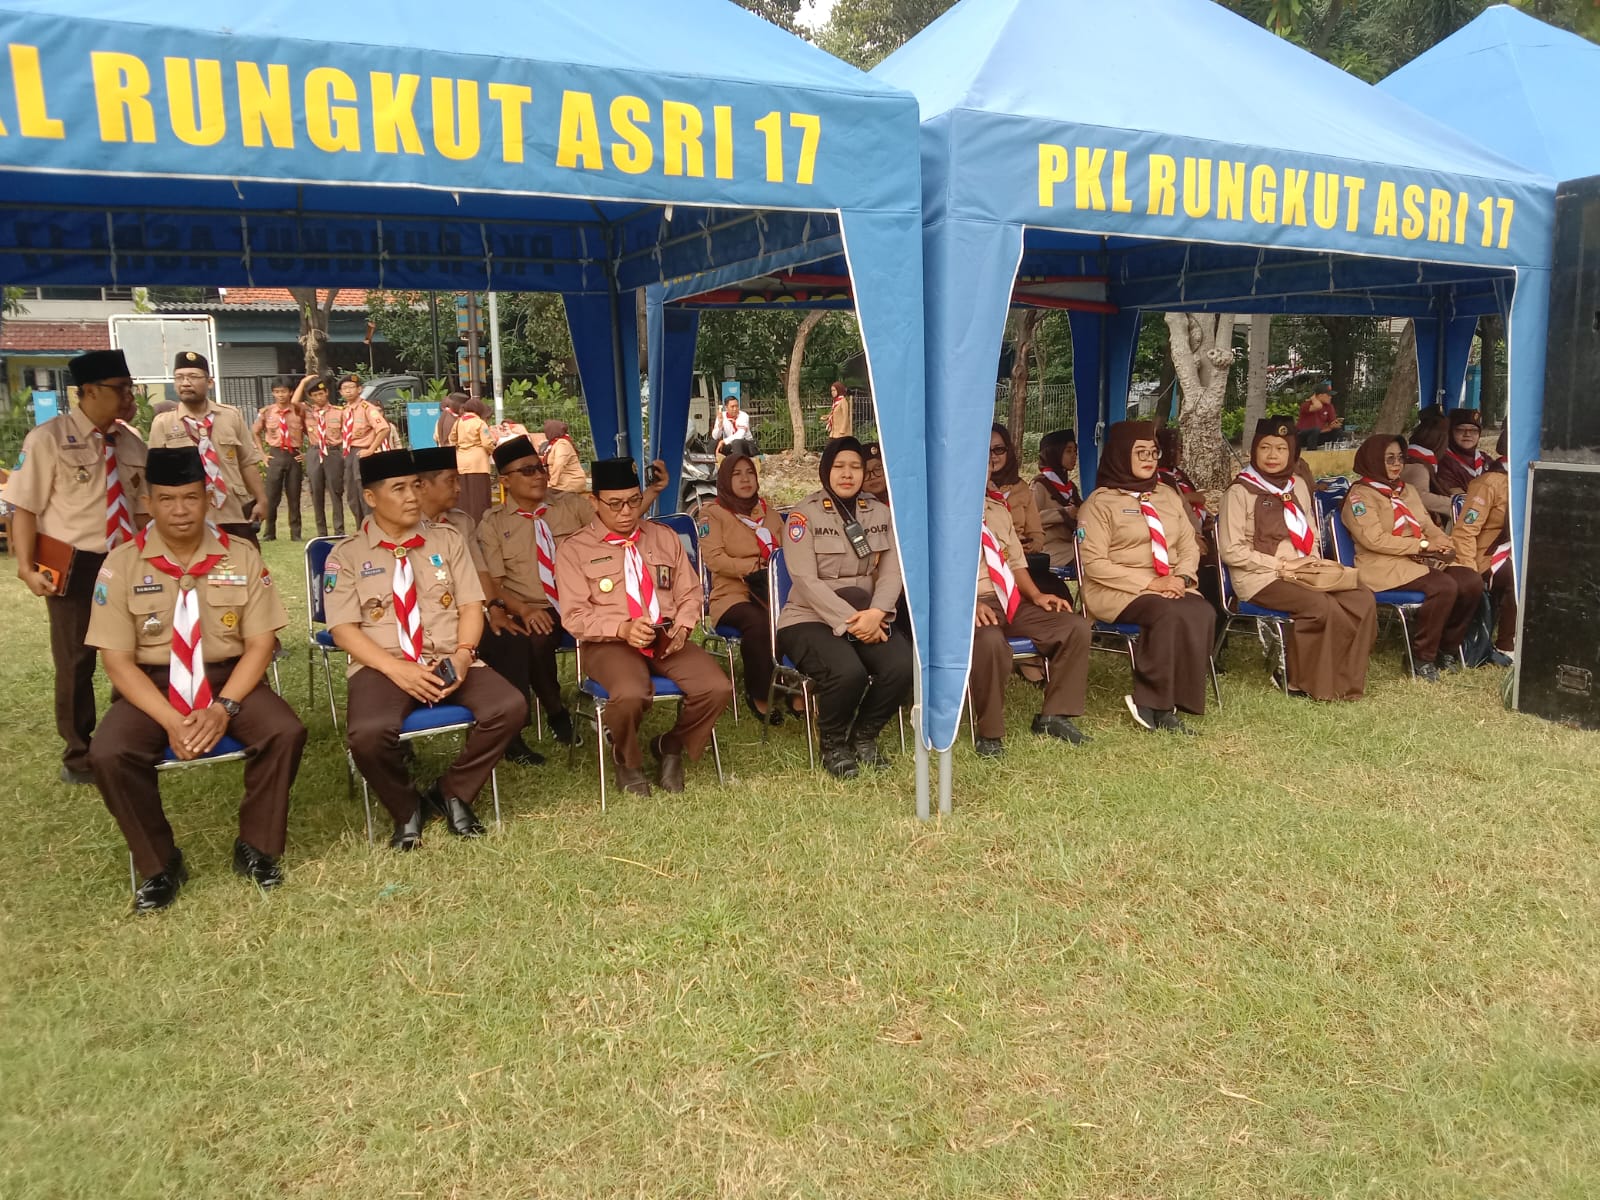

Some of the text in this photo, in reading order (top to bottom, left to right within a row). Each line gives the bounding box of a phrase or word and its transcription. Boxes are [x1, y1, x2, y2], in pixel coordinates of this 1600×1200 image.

[0, 43, 821, 185] L RUNGKUT ASRI 17
[1038, 143, 1515, 249] PKL RUNGKUT ASRI 17
[814, 527, 840, 537] MAYA
